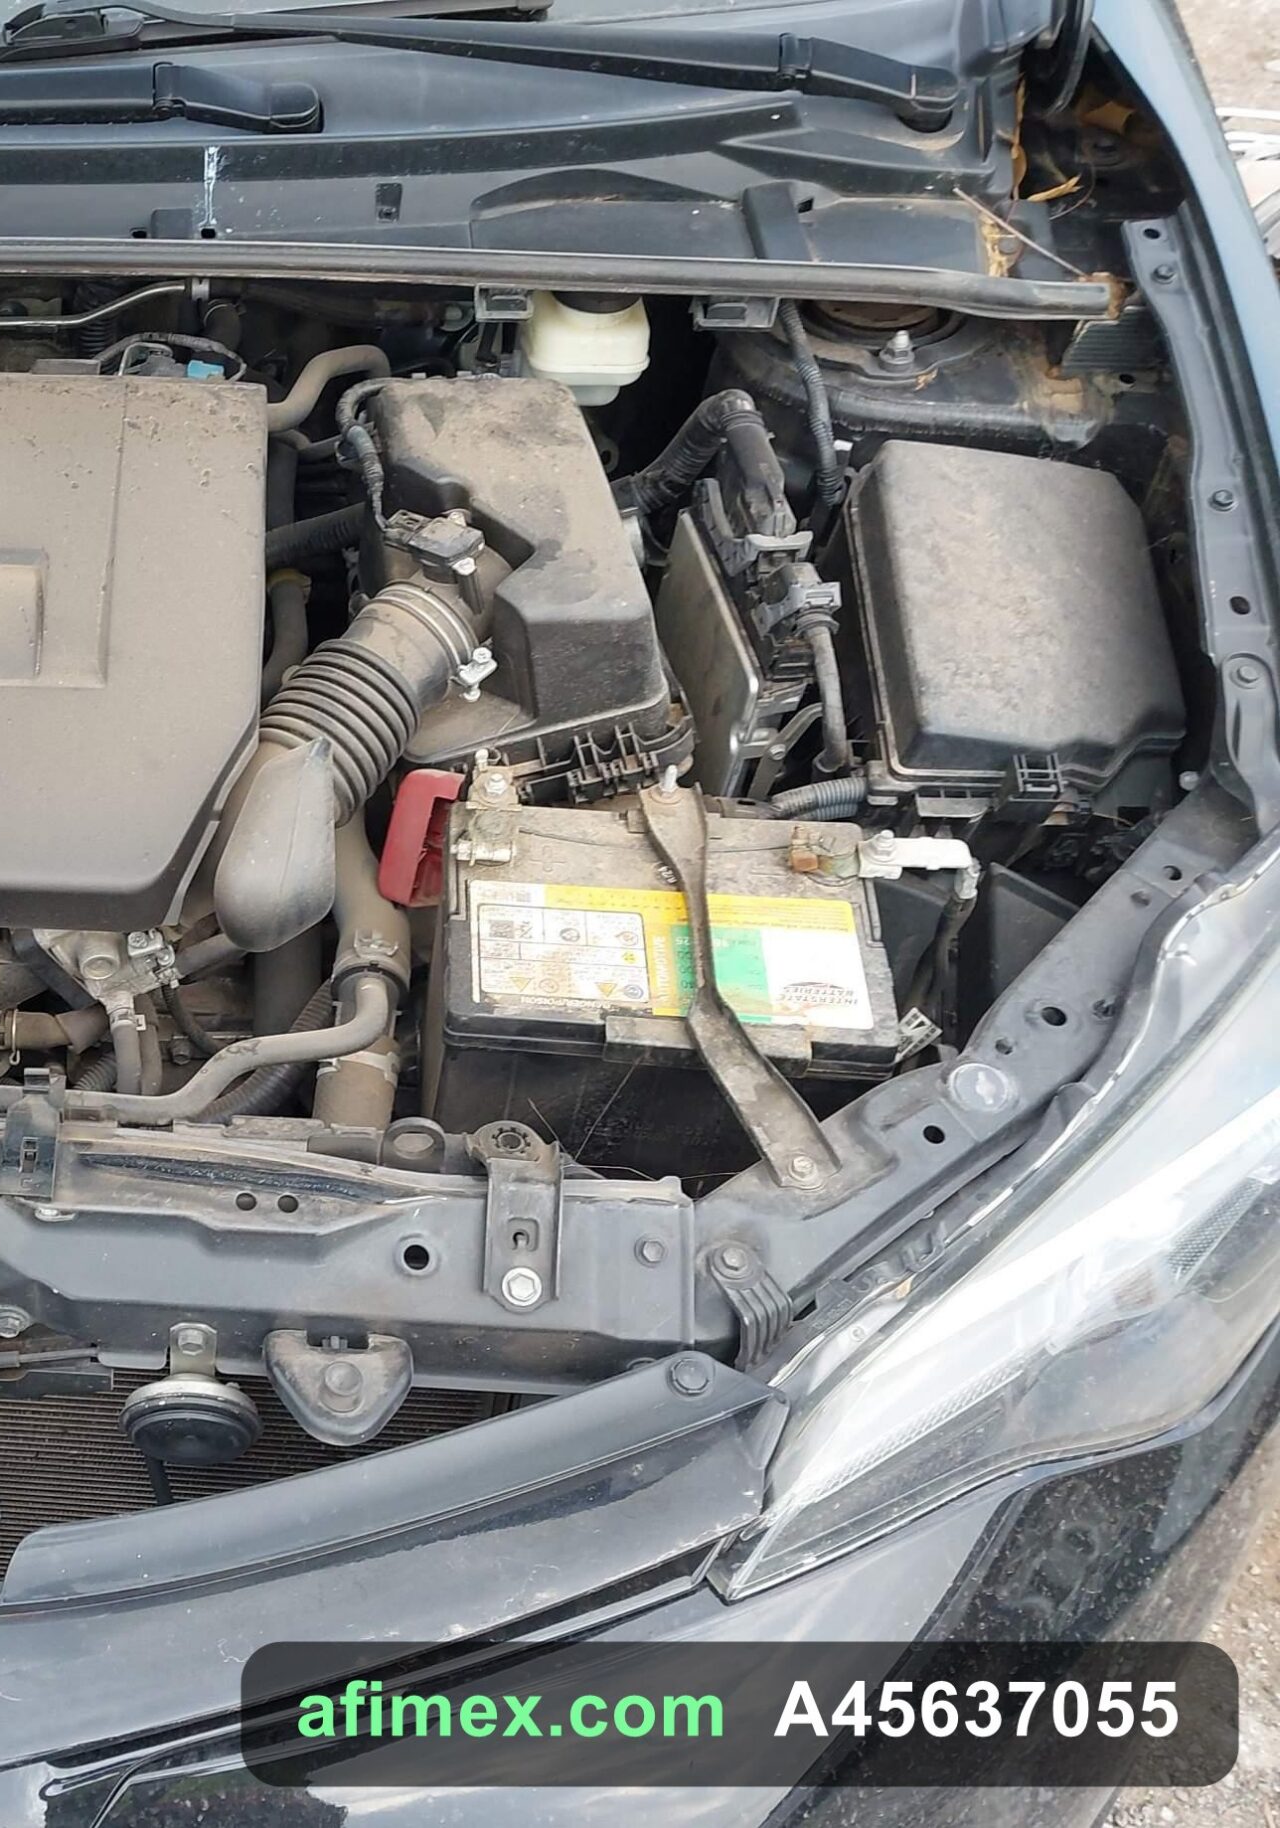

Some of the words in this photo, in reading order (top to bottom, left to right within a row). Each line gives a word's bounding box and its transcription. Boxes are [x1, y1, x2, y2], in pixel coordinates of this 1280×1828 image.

[652, 936, 671, 1002] AUTOMOTIVE
[783, 986, 854, 997] BATTERIES
[777, 994, 858, 1005] INTERSTATE
